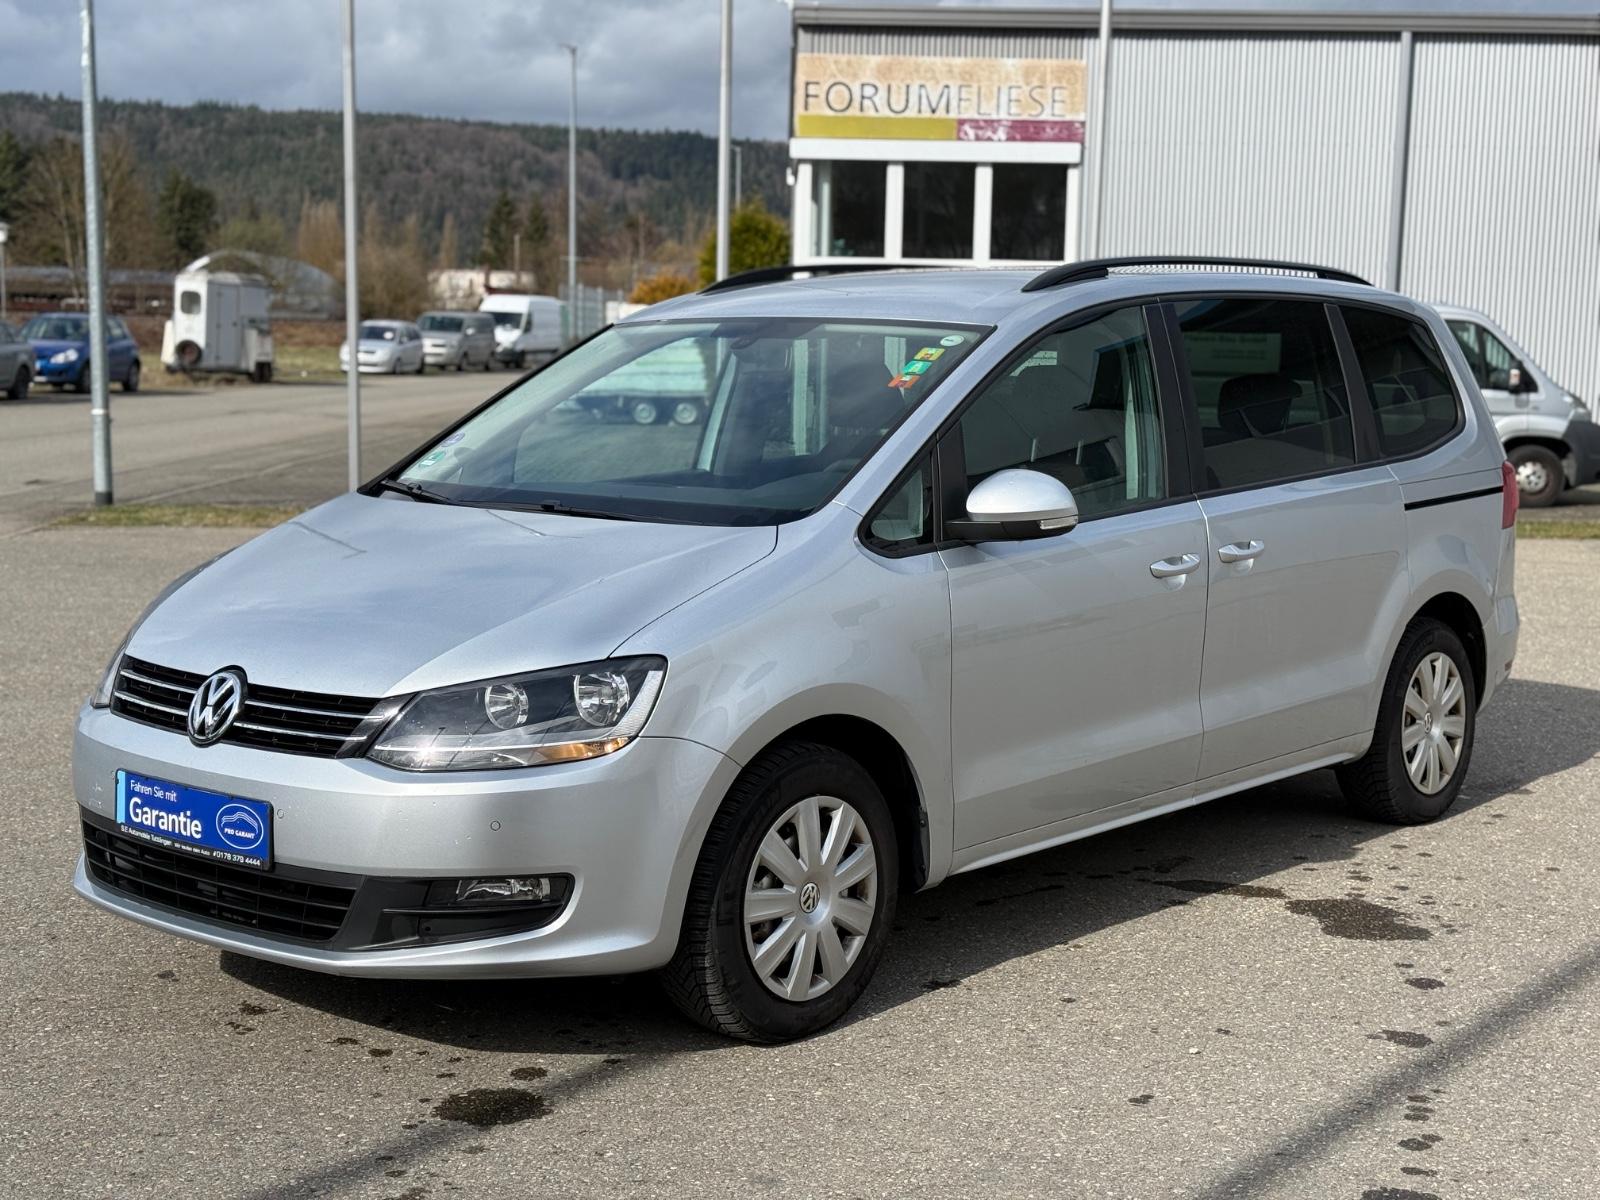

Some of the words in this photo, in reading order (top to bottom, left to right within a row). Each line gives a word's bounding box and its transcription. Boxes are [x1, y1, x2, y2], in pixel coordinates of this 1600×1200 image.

[803, 81, 1067, 118] FORUMFLIESE
[130, 780, 152, 796] Fahren
[153, 786, 164, 799] Sie
[165, 790, 177, 802] mit
[129, 797, 202, 839] Garantie
